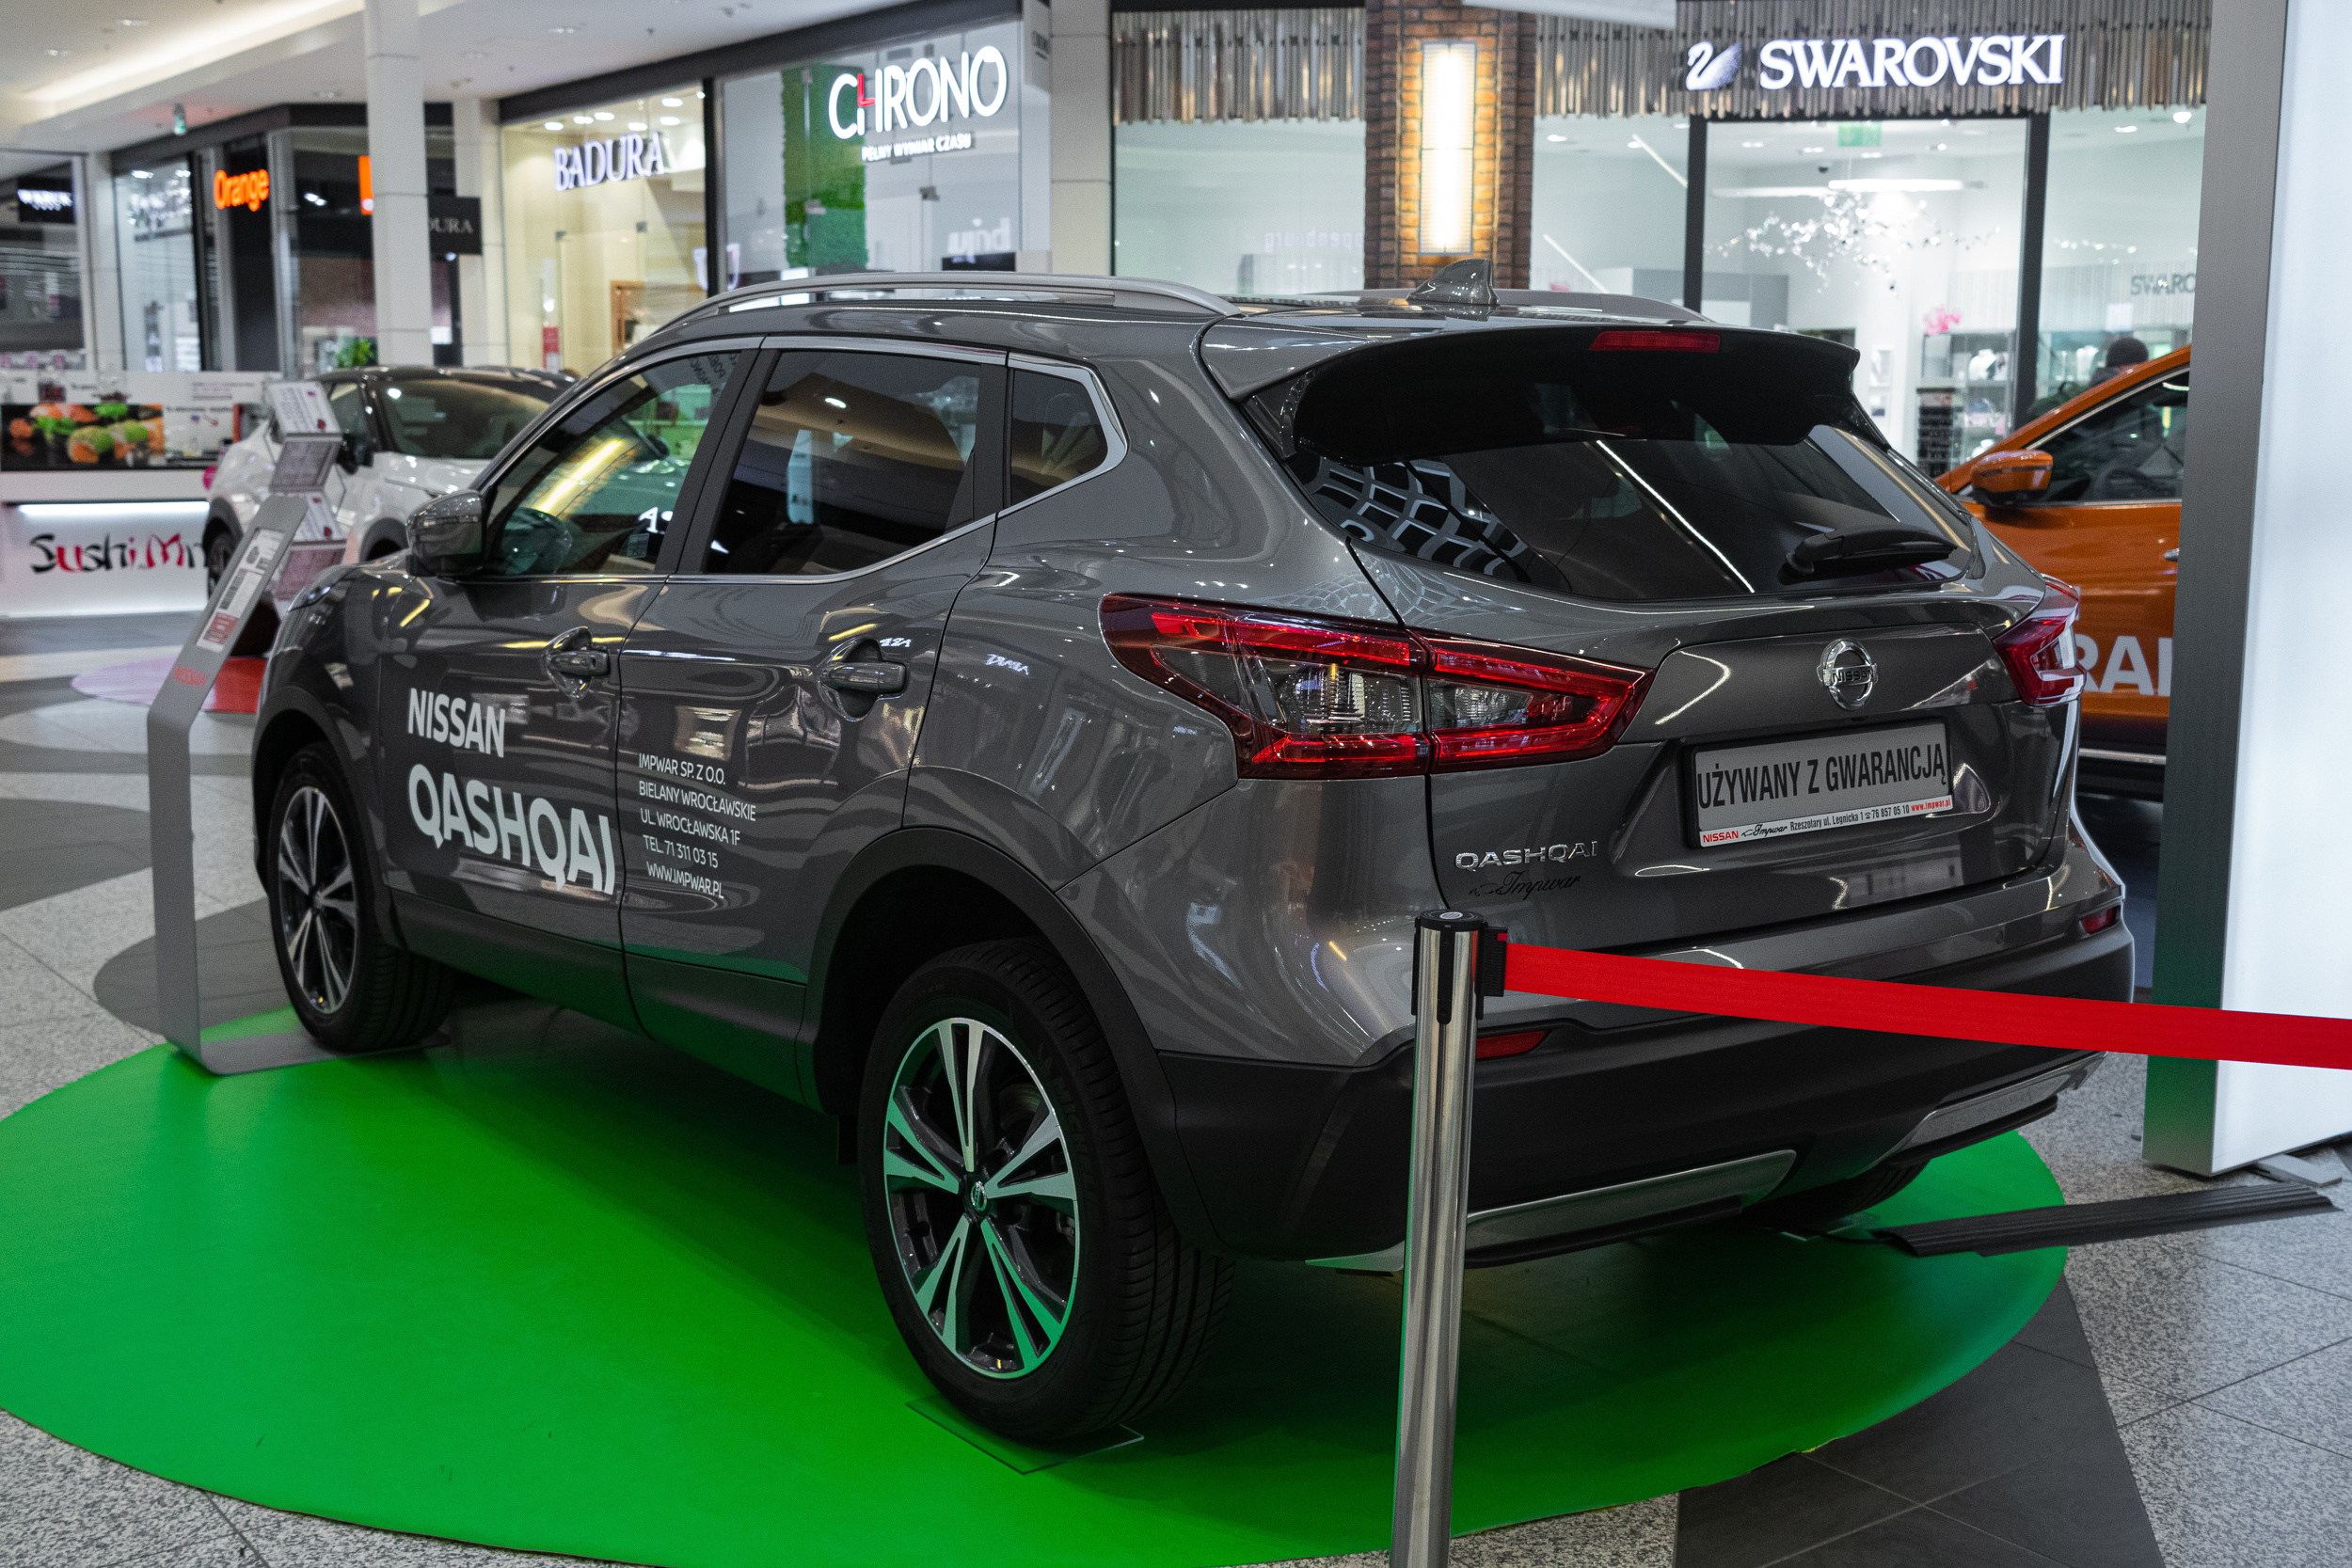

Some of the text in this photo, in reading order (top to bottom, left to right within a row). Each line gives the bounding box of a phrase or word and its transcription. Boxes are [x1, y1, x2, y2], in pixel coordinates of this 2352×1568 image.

[1758, 34, 2067, 90] SWAROVSKI
[828, 45, 1008, 140] CHRONO
[552, 132, 666, 192] BADURA
[935, 133, 972, 152] CZASU
[214, 169, 270, 212] Orange
[29, 532, 137, 574] Sushi
[408, 688, 506, 758] NISSAN
[639, 753, 726, 784] IMPWAR SP. Z O.O.
[1697, 743, 1947, 809] UŻYWANY Z GWARANCJĄ
[639, 781, 756, 821] BIELANY WROCŁAWSKIE
[1702, 830, 1740, 844] NISSAN
[1789, 814, 1822, 832] Rzeszotary
[1832, 809, 1859, 825] Legnicka
[1860, 808, 1864, 821] 1
[1870, 805, 1880, 820] 76
[1881, 802, 1892, 818] 857
[1893, 802, 1901, 816] 05
[1902, 804, 1910, 815] 10
[1911, 799, 1951, 813] www.impwar.pl
[409, 764, 615, 895] QASHQAI
[656, 812, 729, 844] WROCŁAWSKA
[730, 829, 740, 846] 1F
[664, 840, 675, 857] 71
[675, 844, 691, 862] 311
[692, 847, 707, 865] 03
[707, 851, 719, 868] 15
[1455, 841, 1597, 872] QASHQAI
[646, 862, 724, 899] WWW.IMPWAR.PL
[1496, 871, 1581, 900] Impwar
